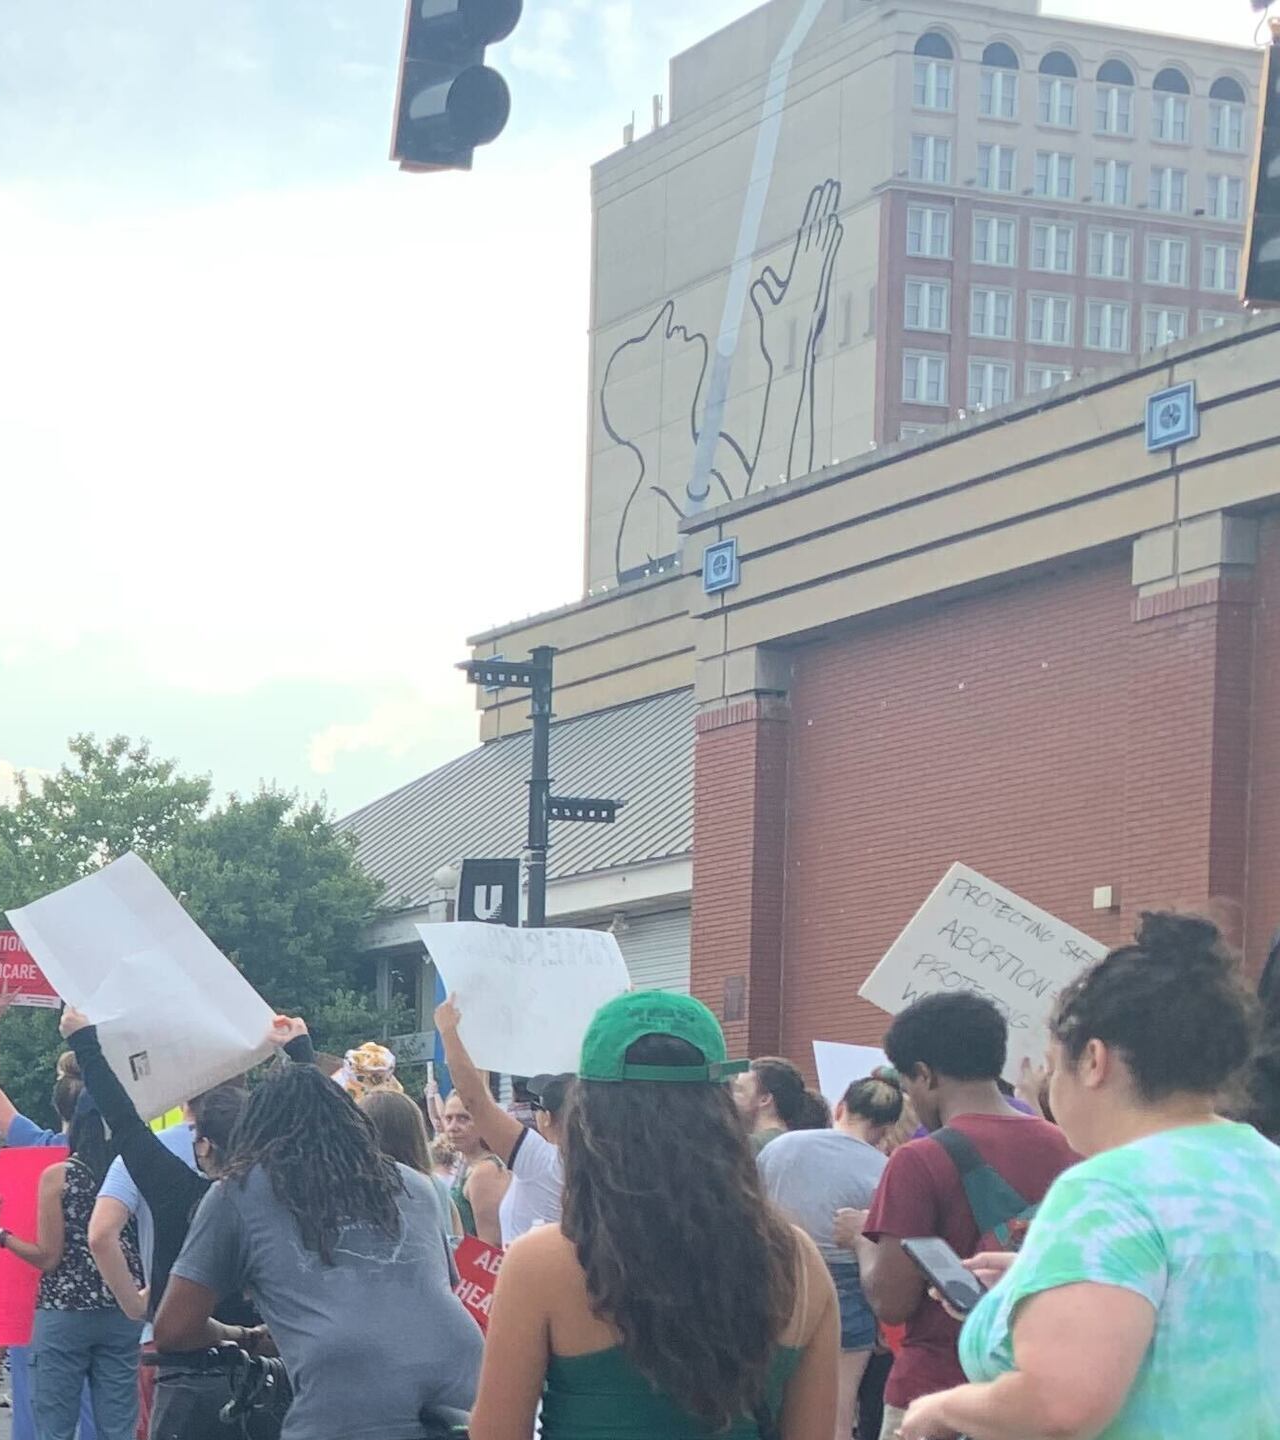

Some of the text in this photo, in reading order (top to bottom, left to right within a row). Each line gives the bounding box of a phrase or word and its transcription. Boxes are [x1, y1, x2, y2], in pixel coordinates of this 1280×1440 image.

[937, 919, 1055, 998] ABORTION
[948, 878, 1098, 963] PROTECTING SAF
